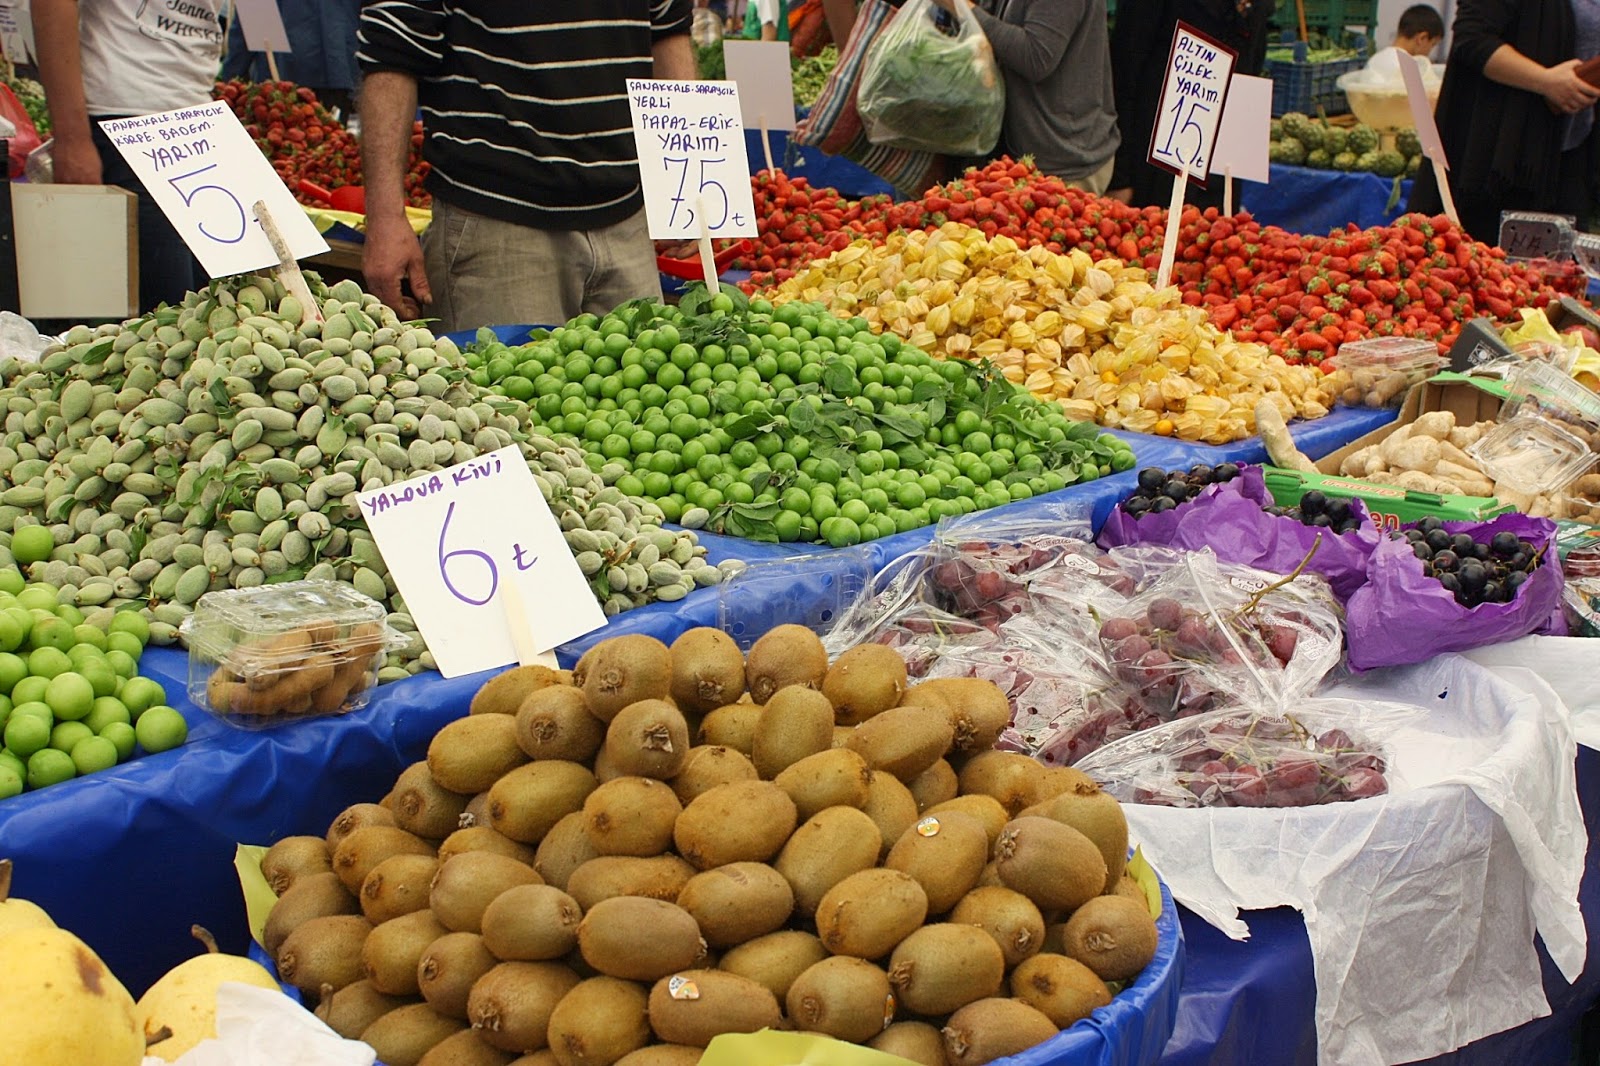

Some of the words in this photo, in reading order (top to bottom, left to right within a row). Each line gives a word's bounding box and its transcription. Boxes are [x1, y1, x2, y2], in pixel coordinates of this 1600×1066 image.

[166, 0, 218, 24] Jenne
[1177, 36, 1217, 63] ALTIN
[1156, 95, 1211, 165] 15
[167, 163, 247, 244] 5
[361, 475, 444, 517] YALOVA
[438, 500, 499, 606] 6
